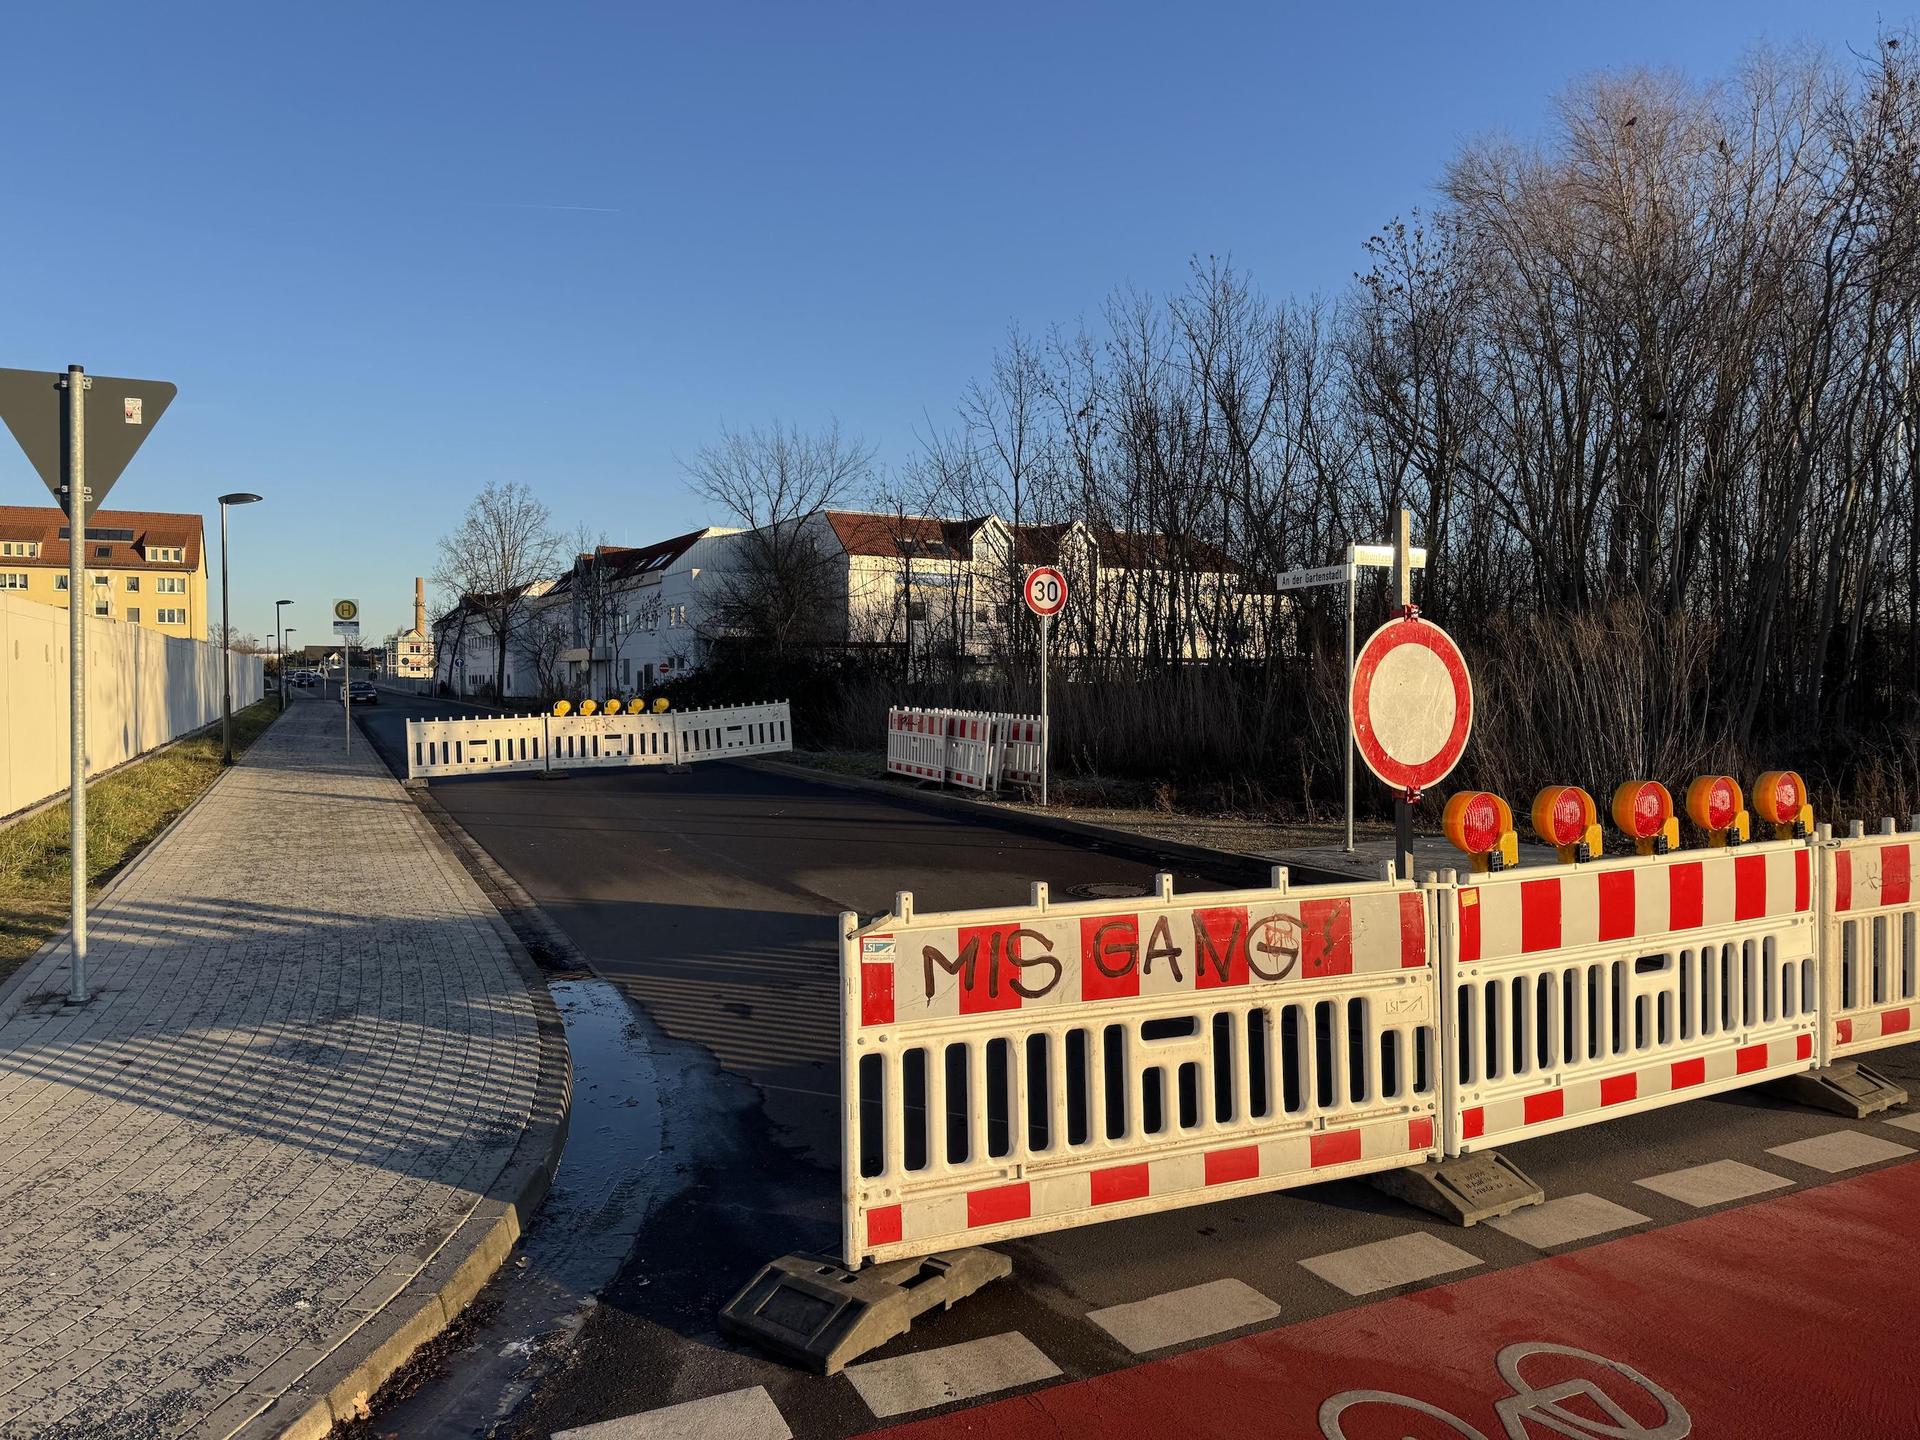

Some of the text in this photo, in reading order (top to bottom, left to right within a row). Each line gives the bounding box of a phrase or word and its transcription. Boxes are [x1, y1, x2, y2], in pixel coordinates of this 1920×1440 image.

[1282, 569, 1342, 586] An der Gartenstadt
[1034, 580, 1058, 602] 30
[341, 604, 351, 616] H
[863, 943, 876, 952] LSI
[922, 928, 1063, 1003] MIS
